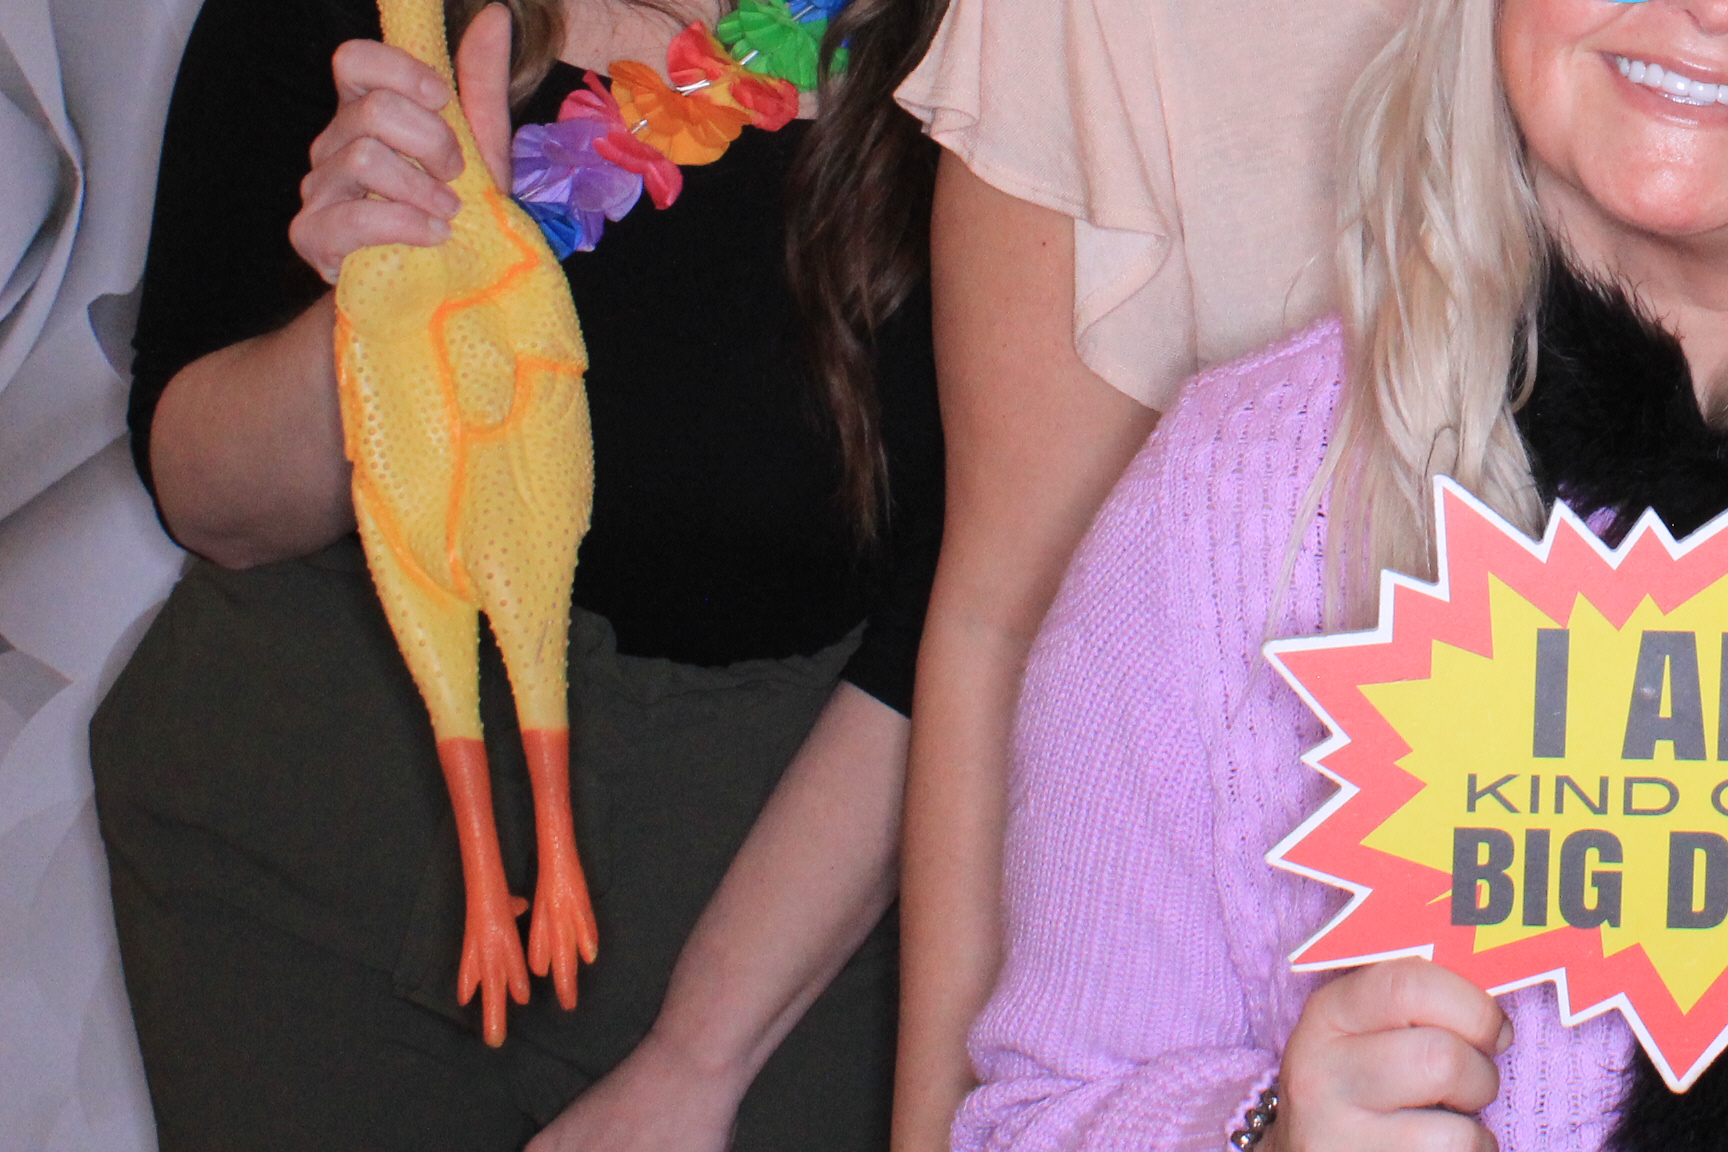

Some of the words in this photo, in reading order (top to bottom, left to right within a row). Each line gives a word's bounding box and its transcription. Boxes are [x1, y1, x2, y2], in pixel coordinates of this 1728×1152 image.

[1533, 628, 1569, 758] I
[1467, 773, 1679, 816] KIND
[1452, 827, 1623, 929] BIG
